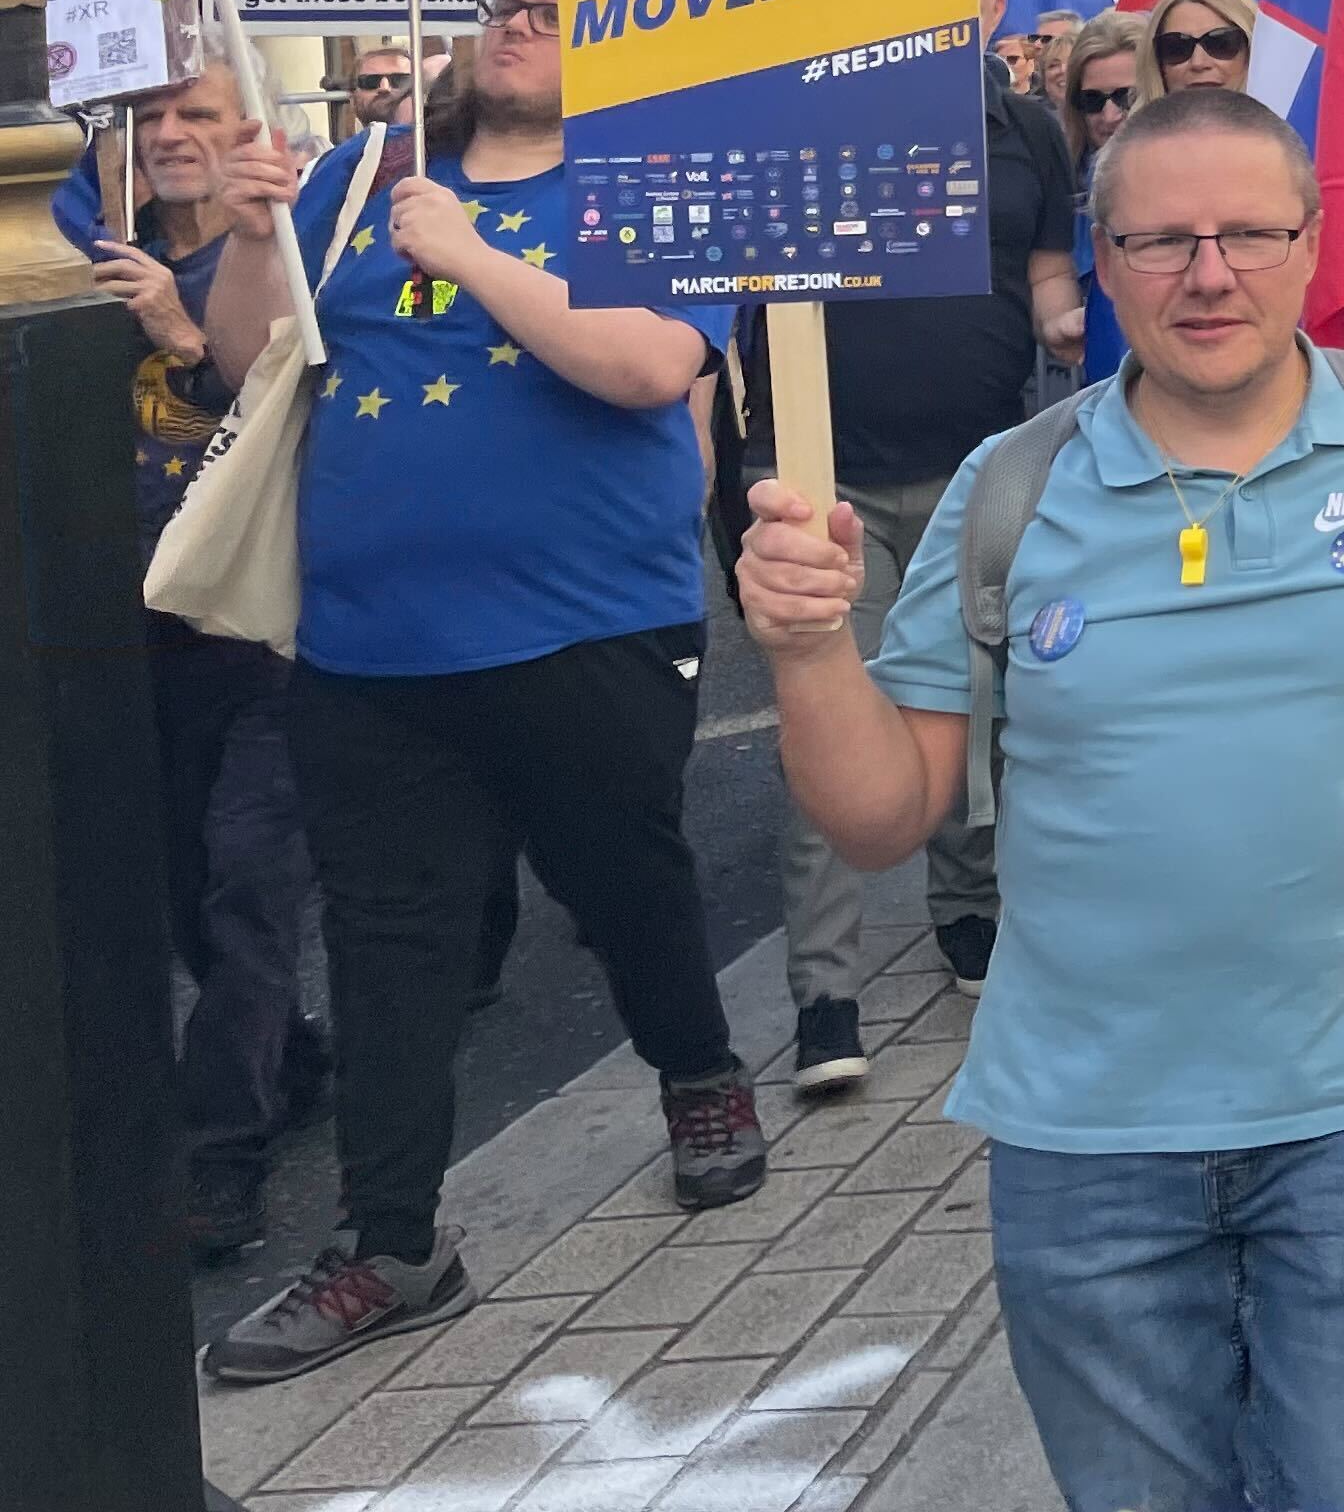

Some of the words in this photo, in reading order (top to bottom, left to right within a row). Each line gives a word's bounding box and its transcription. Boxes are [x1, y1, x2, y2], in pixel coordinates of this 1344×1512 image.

[64, 0, 110, 24] #XR
[801, 24, 971, 84] #REJOINEU
[671, 272, 882, 295] MARCHFORREJOIN.CO.UK
